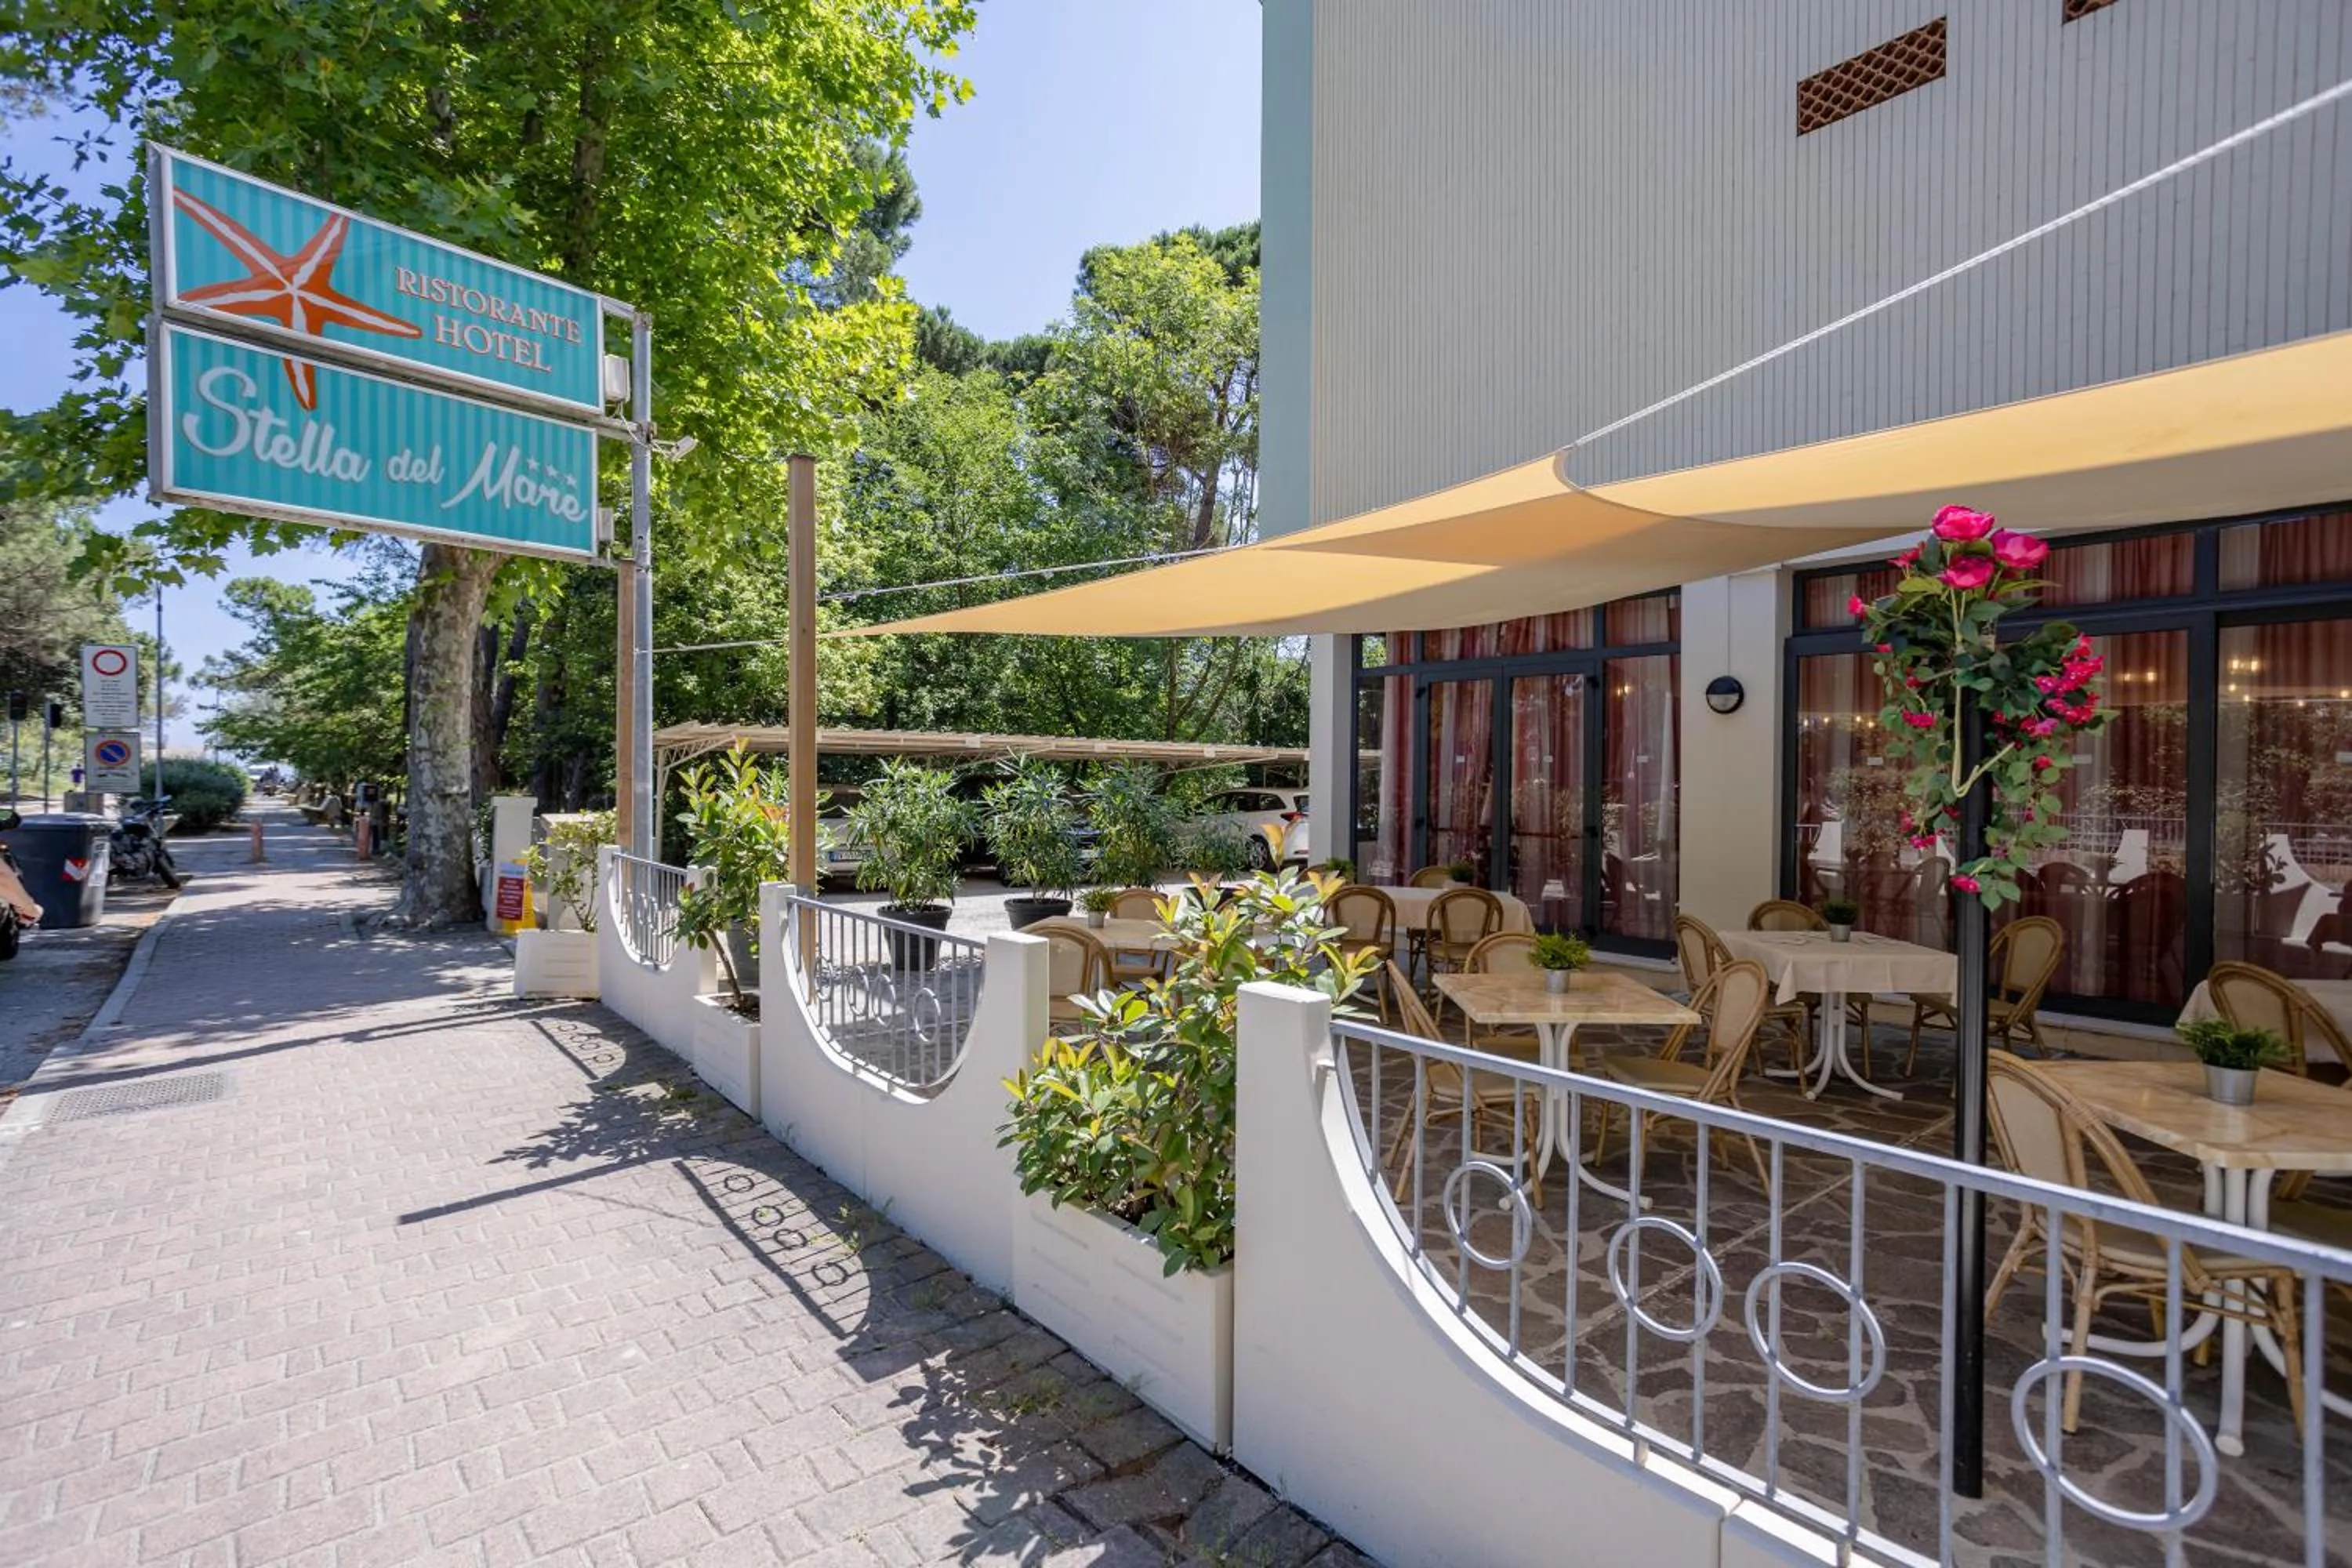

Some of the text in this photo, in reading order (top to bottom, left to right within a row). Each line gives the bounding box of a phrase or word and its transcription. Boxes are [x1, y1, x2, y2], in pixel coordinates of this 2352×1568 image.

[397, 267, 580, 343] RISTORANTE
[436, 316, 551, 372] HOTEL
[183, 367, 586, 522] Stella del Mare
